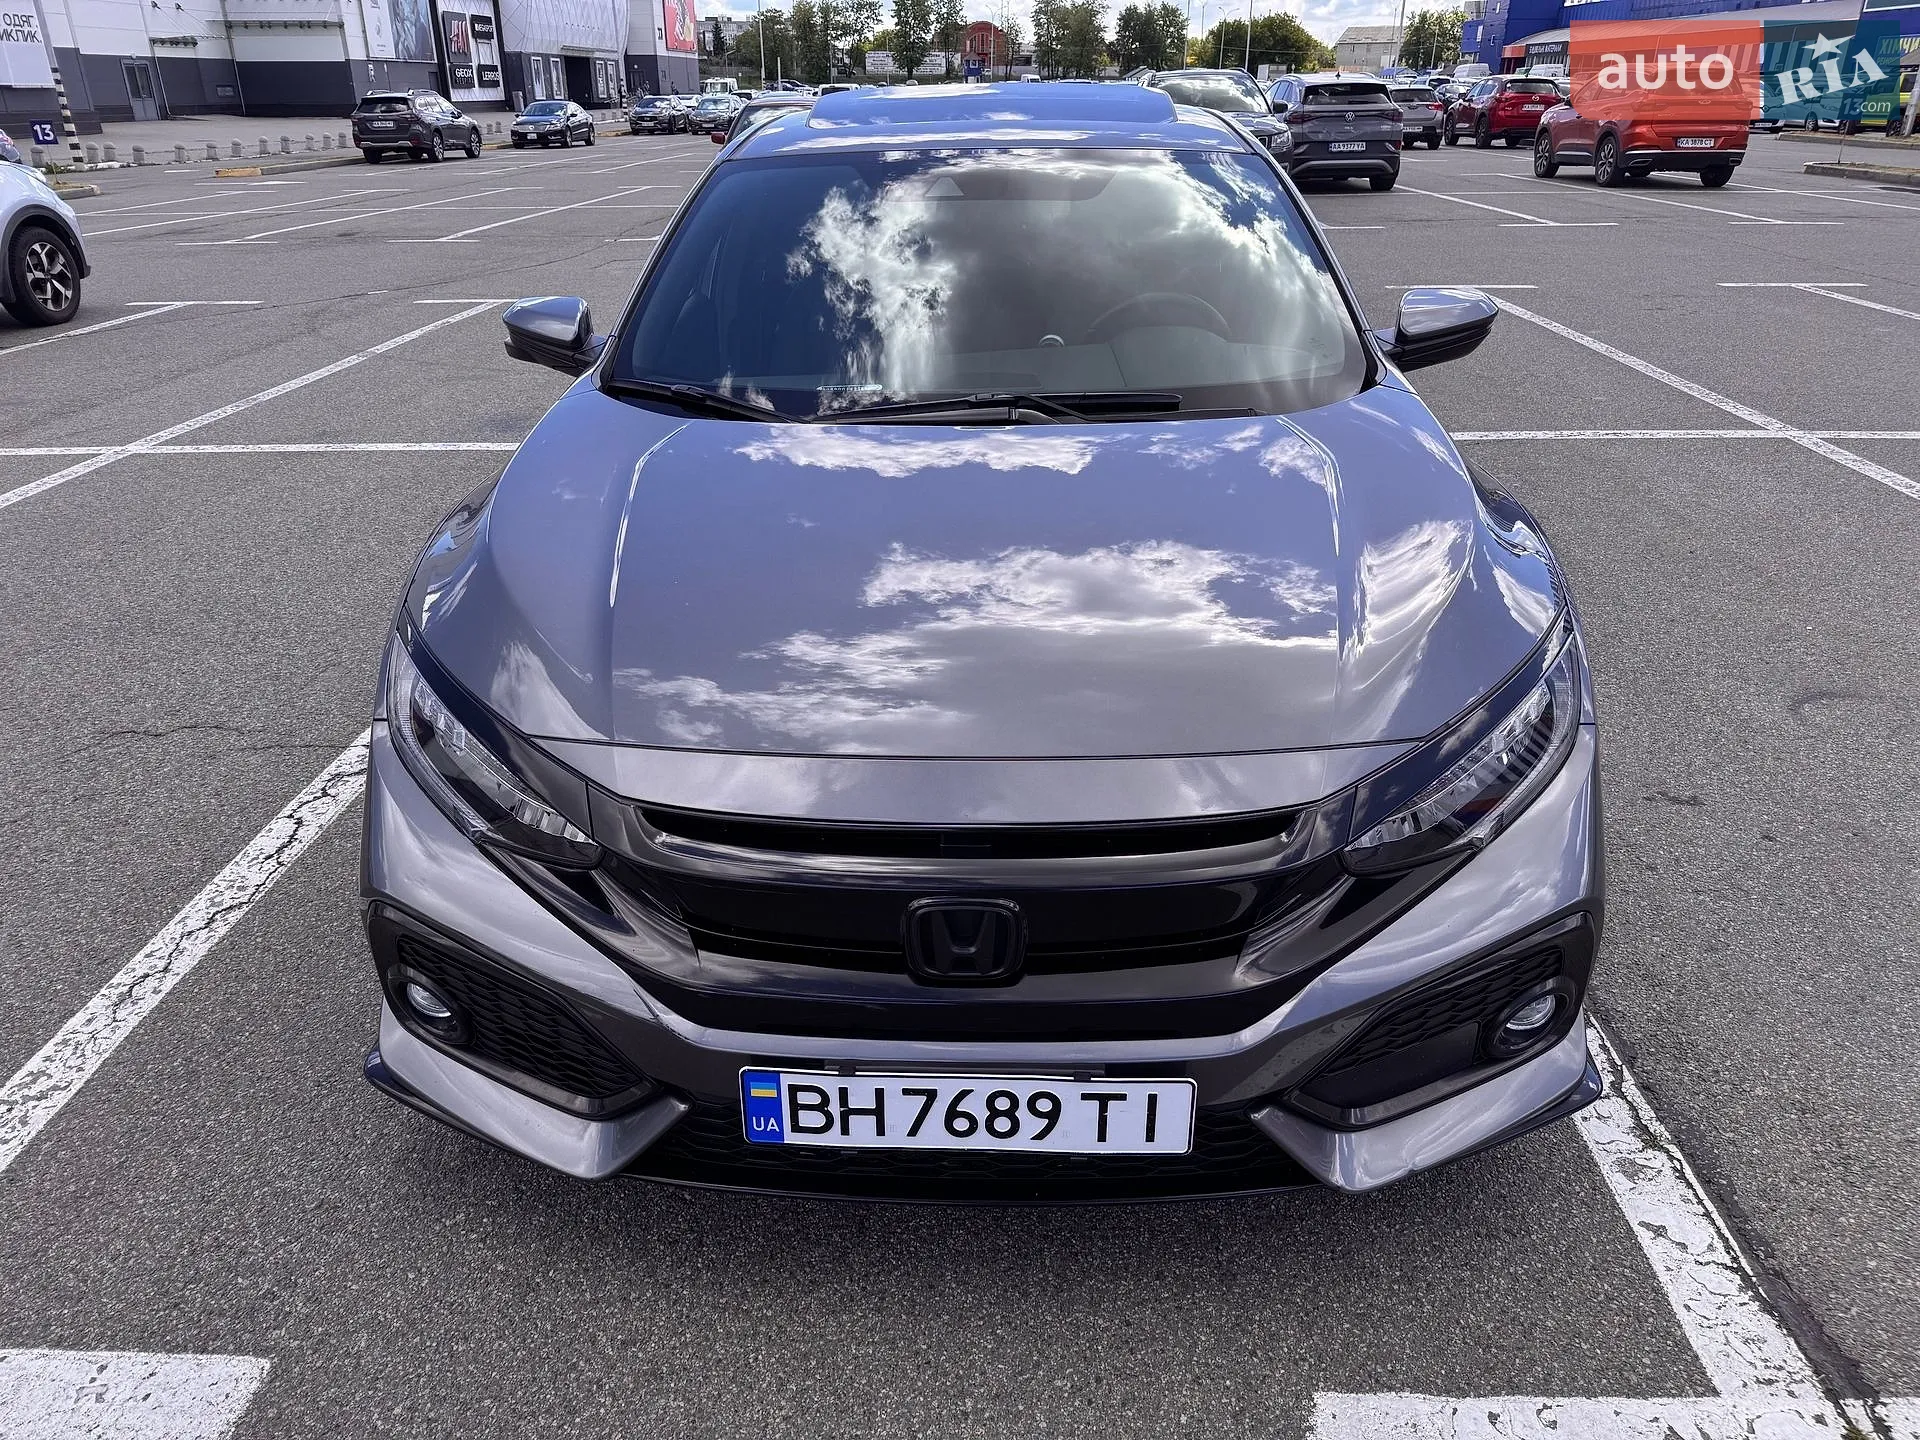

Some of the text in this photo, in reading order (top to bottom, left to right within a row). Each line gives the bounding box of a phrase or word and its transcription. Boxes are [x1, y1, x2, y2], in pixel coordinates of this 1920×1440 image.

[455, 68, 473, 78] GEOX
[33, 124, 54, 141] 13
[787, 1083, 1159, 1143] BH 7689 TI
[752, 1115, 780, 1133] UA
